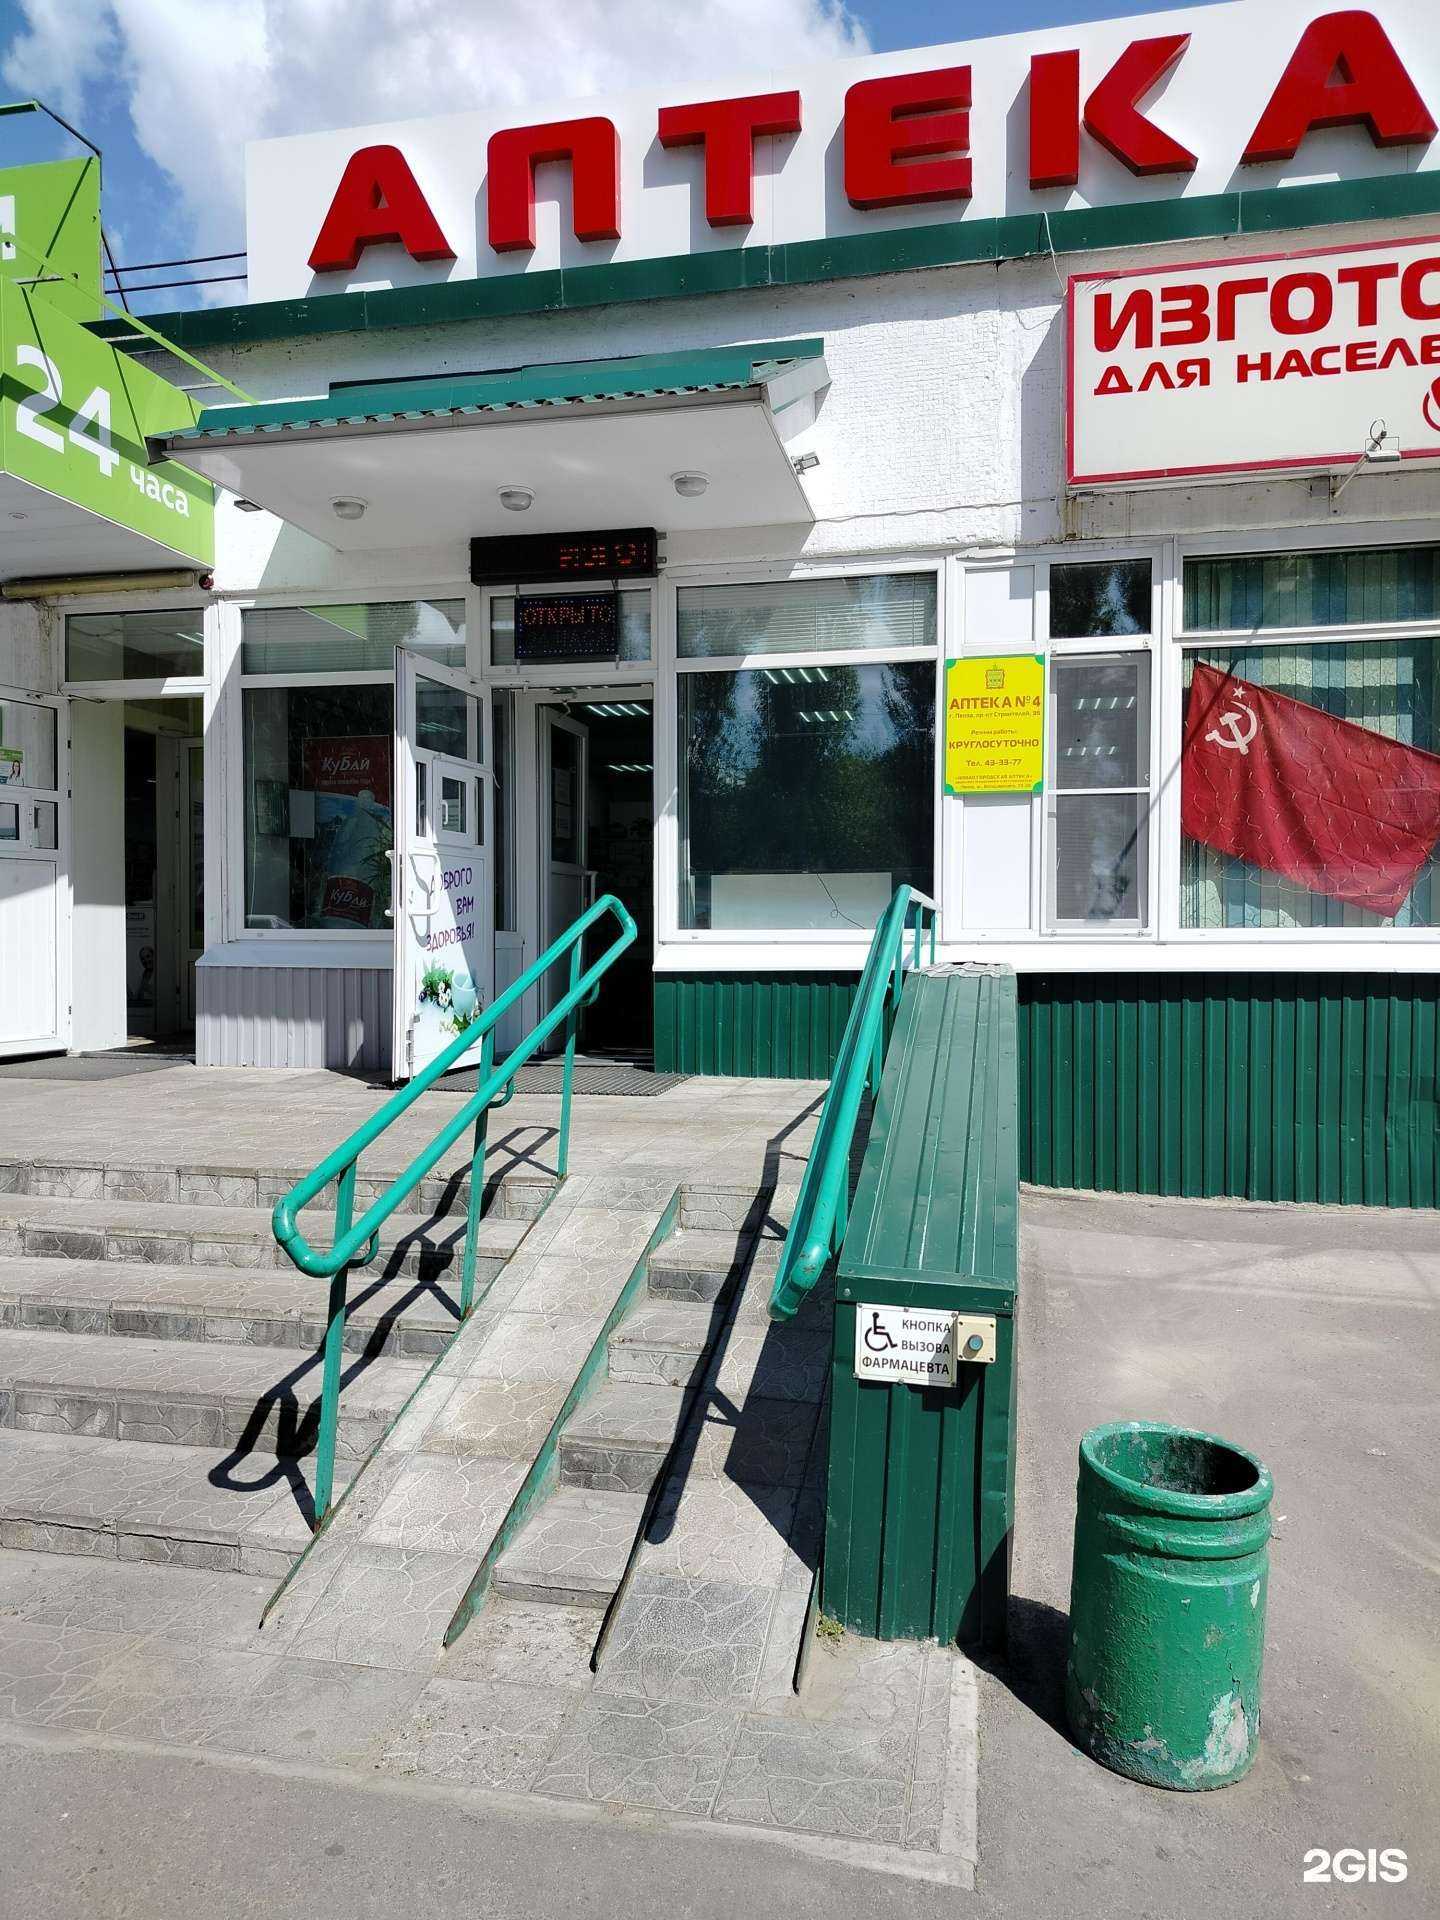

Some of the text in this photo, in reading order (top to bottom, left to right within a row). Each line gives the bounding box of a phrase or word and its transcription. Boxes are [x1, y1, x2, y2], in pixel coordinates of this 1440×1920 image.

[307, 9, 1440, 273] АПТЕКА
[1093, 256, 1440, 353] ИЗГОТО
[1094, 357, 1211, 396] ДЛЯ
[16, 344, 190, 517] 24 часа
[523, 605, 613, 625] ОТКРЫТО
[949, 695, 1012, 710] АПТЕКА
[948, 738, 1040, 750] КРУГЛОСУТОЧНО
[966, 759, 982, 767] Тел.
[456, 896, 474, 916] ВАМ
[426, 922, 475, 952] ЗДОРОВЬЯ!
[902, 1319, 951, 1334] КНОПКА
[901, 1340, 950, 1354] ВЫЗОВА
[862, 1356, 950, 1375] ФАРМАЦЕВТА
